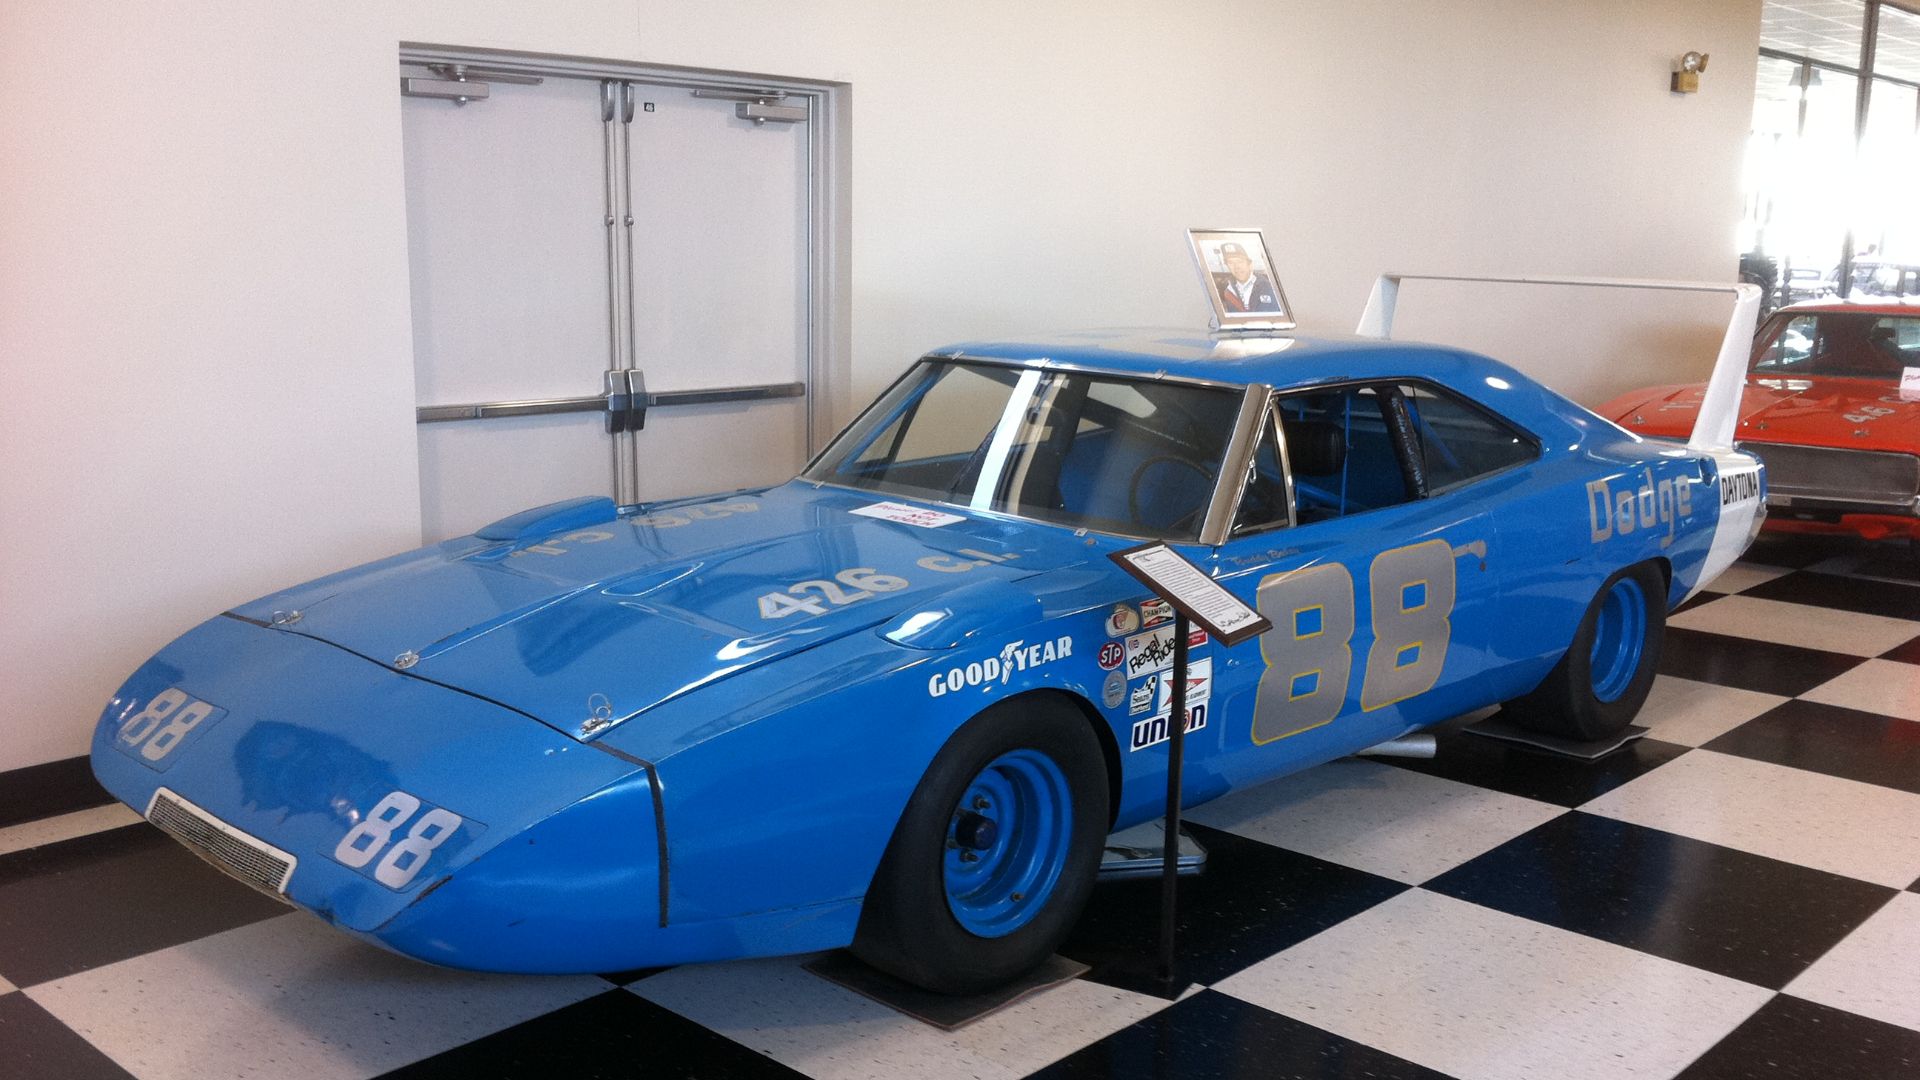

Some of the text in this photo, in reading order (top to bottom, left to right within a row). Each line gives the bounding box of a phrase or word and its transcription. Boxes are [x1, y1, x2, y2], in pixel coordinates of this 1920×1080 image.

[1586, 467, 1692, 548] Dodge
[1721, 472, 1758, 505] DAYTONA
[758, 567, 909, 619] 426
[928, 635, 1073, 698] GOODYEAR
[1101, 643, 1121, 664] STP
[1129, 633, 1160, 674] Regal
[1151, 637, 1176, 667] Ride
[1251, 538, 1456, 746] 88
[118, 686, 215, 762] 88
[334, 790, 463, 889] 88
